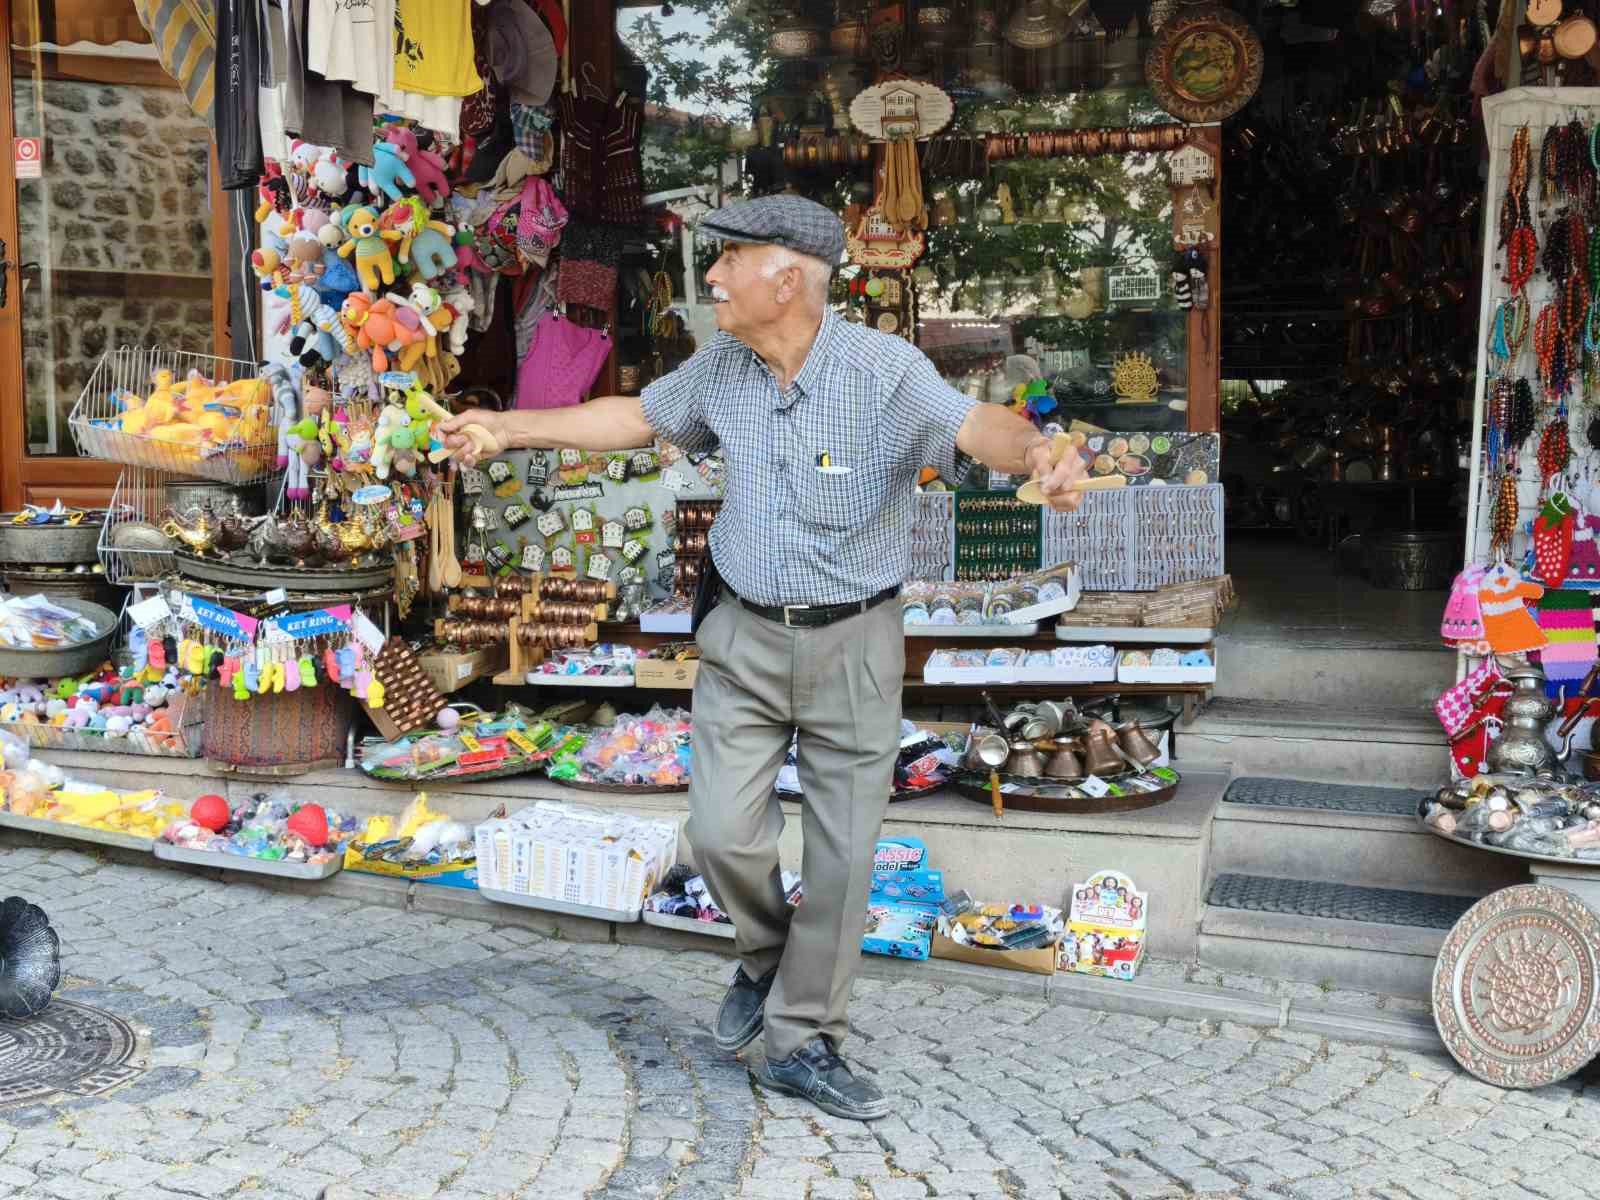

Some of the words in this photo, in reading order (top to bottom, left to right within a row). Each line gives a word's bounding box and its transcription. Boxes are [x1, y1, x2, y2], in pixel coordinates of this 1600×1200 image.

[197, 606, 214, 619] KEY
[215, 613, 238, 628] RING
[287, 620, 307, 631] KEY
[308, 615, 334, 627] RING
